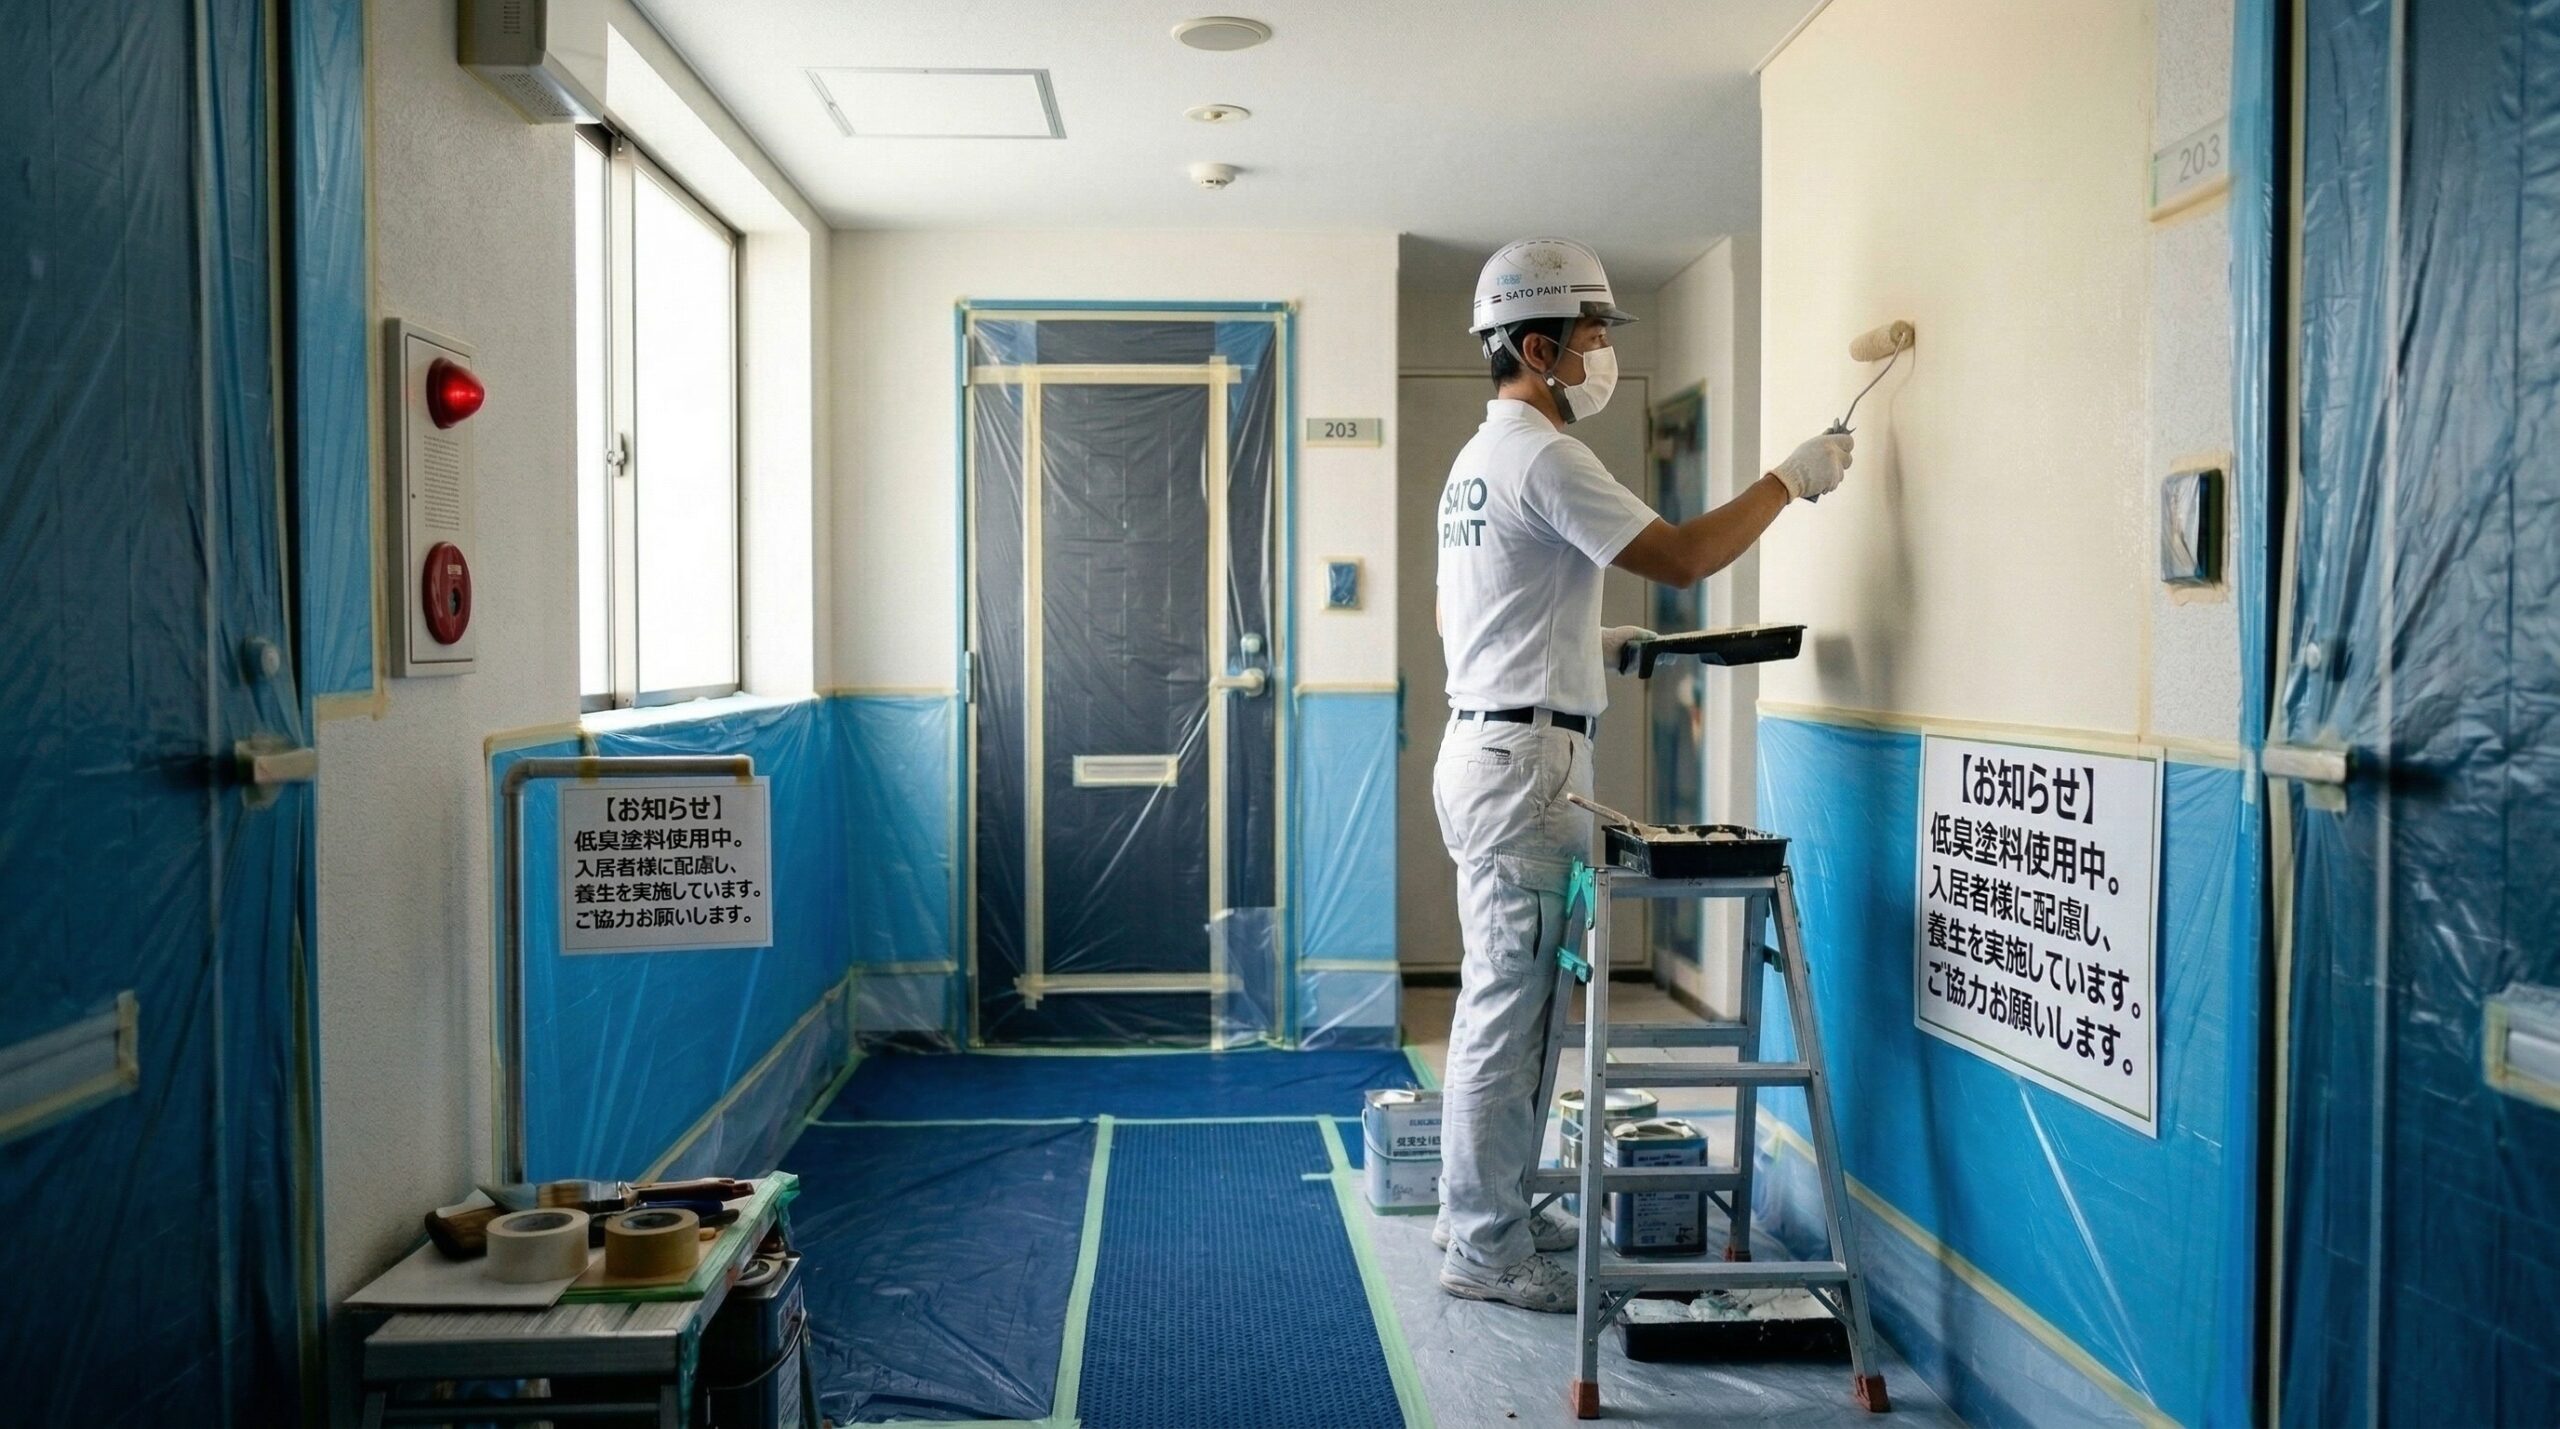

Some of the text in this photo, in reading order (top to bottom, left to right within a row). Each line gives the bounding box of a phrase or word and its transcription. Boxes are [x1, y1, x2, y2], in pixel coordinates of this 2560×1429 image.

[2180, 133, 2220, 183] 203
[1505, 284, 1568, 300] SATO PAINT
[1325, 422, 1357, 438] 203
[1444, 477, 1487, 515] SATO
[1962, 754, 2094, 824] 【お知らせ】
[607, 795, 722, 822] 【お知らせ】
[574, 828, 742, 852] 低臭塗料使用中。
[1931, 812, 2119, 895] 低臭塗料使用中。
[574, 855, 737, 878] 入居者様に配慮し、
[575, 879, 761, 904] 養生を実施しています。
[575, 905, 751, 929] ご協力お願いします。
[1929, 864, 2111, 952] 入居者様に配慮し、
[1928, 910, 2141, 1019] 養生を実施しています。
[1928, 961, 2133, 1076] ご協力お願いします。
